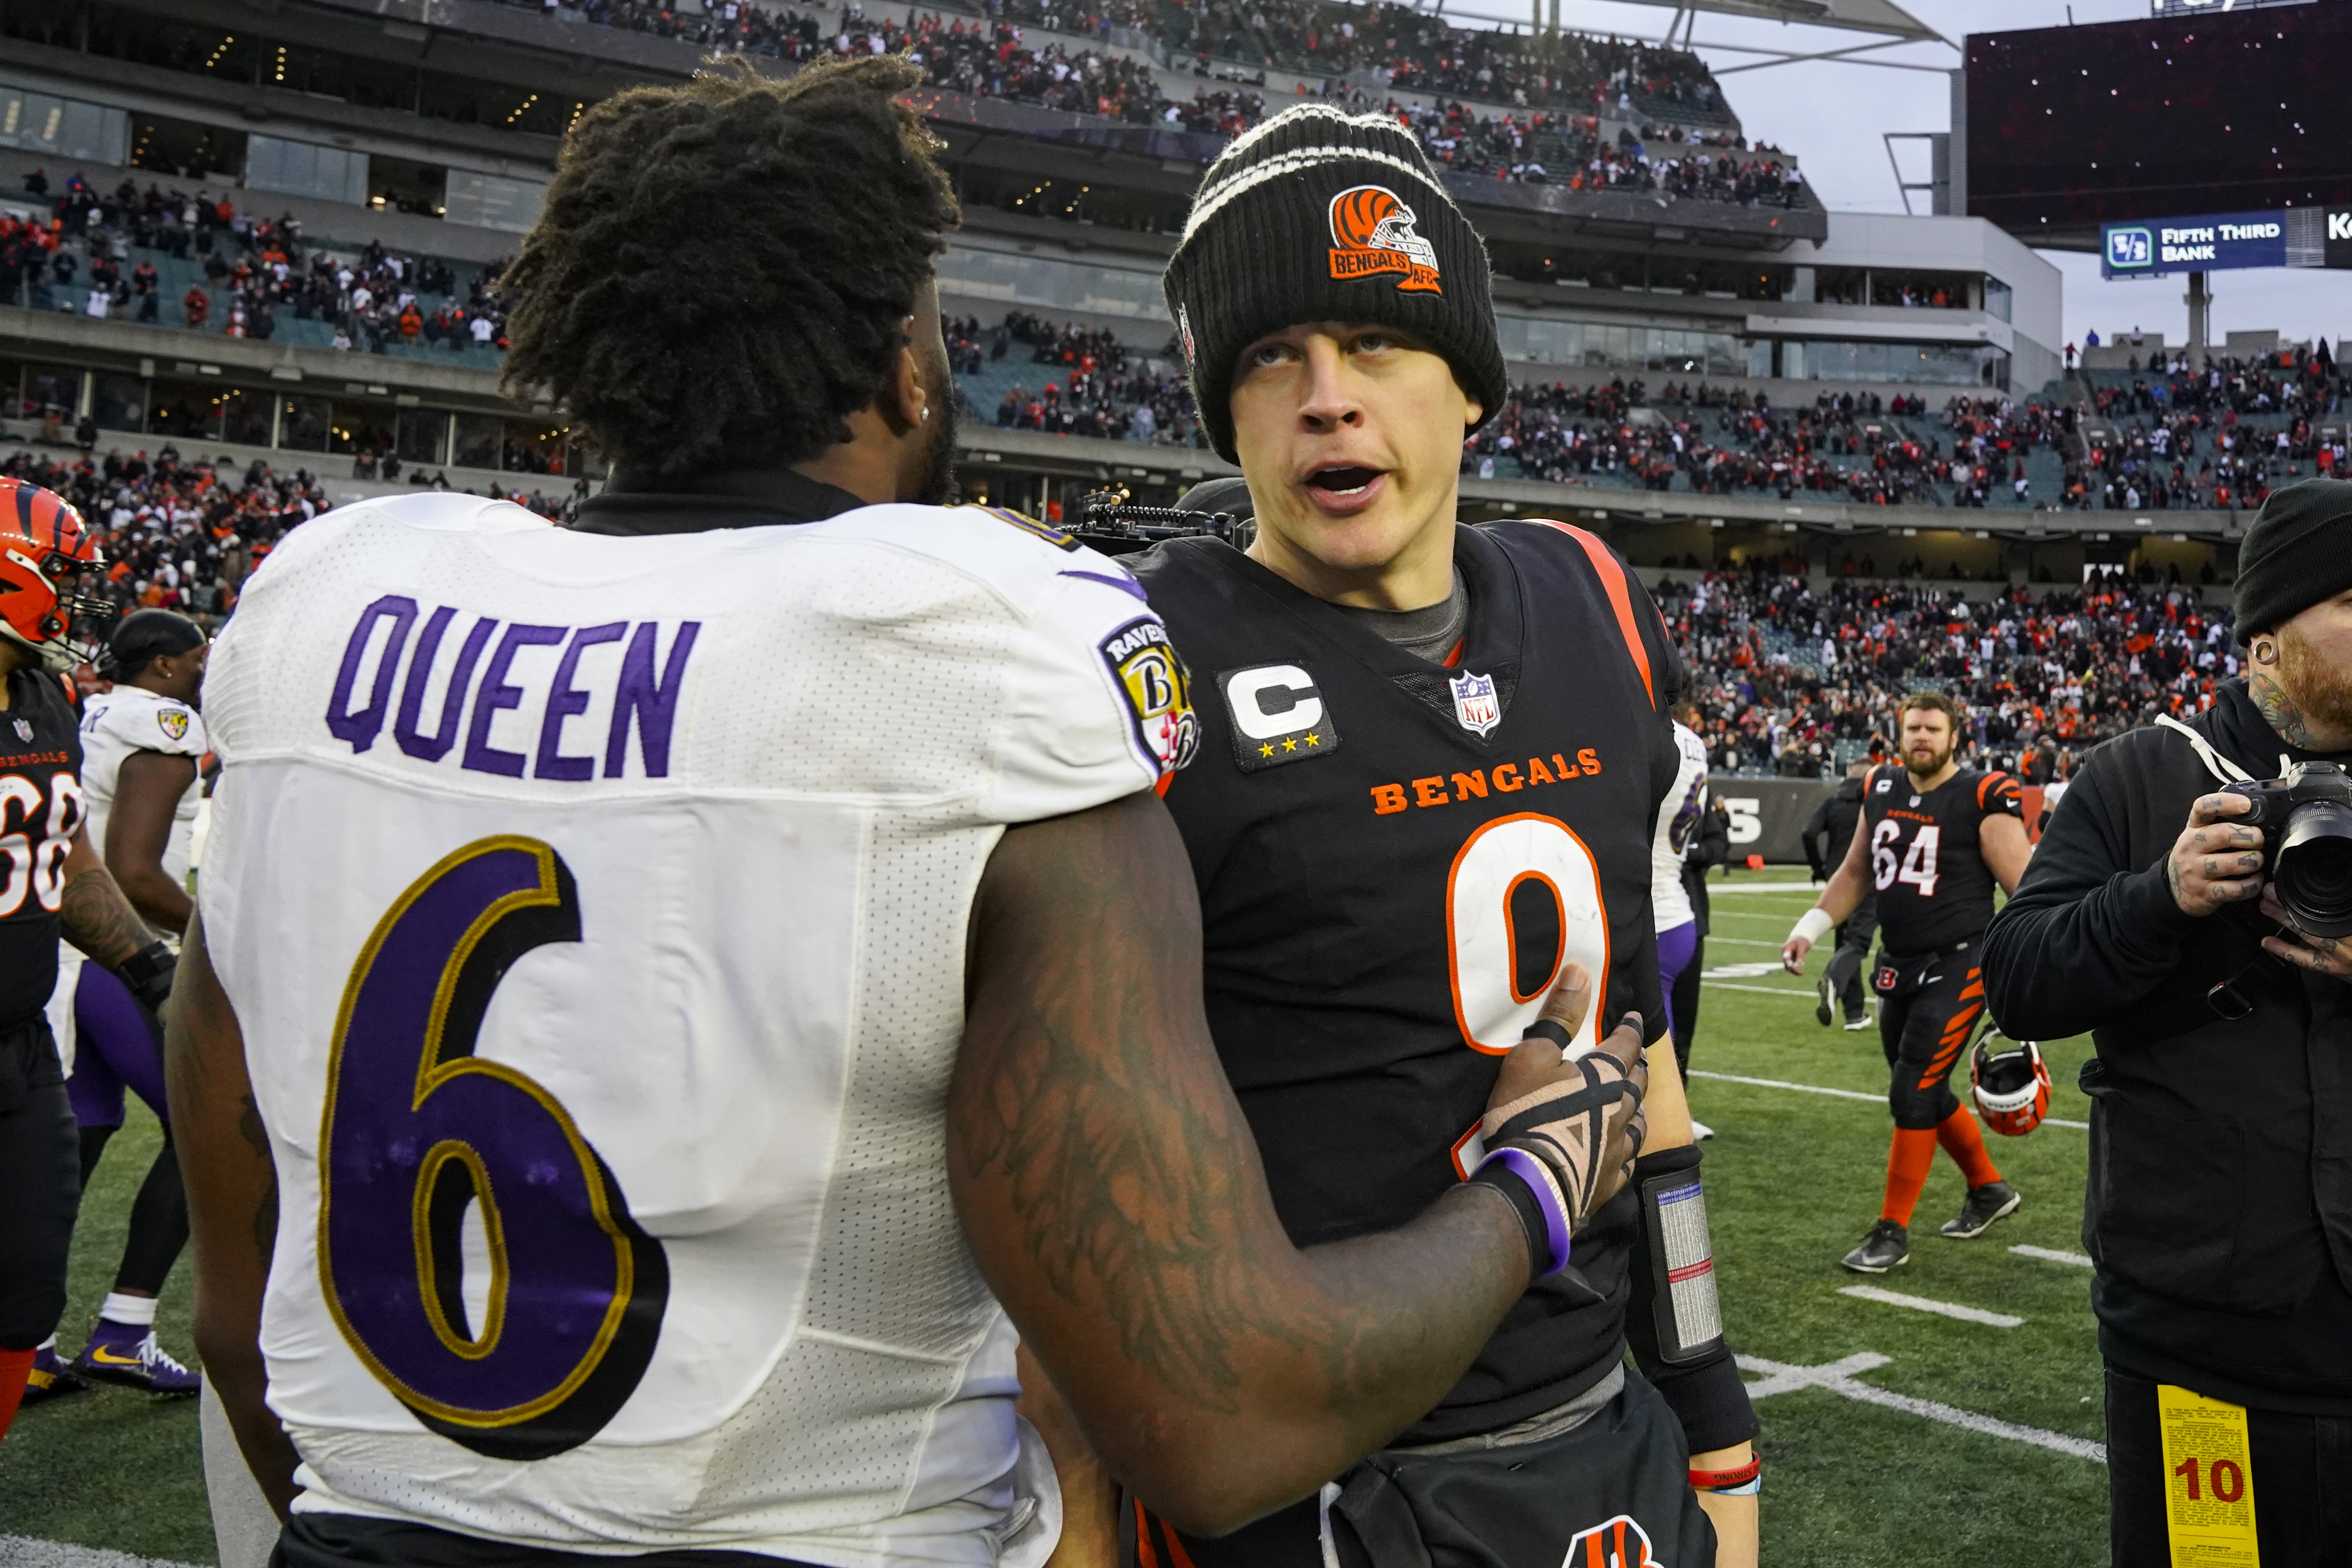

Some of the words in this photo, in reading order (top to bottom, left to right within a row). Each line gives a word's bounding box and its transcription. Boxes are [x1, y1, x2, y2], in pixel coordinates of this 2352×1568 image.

[2161, 227, 2214, 245] FIFTH
[2218, 223, 2281, 241] THIRD
[2328, 212, 2352, 240] K
[1334, 253, 1407, 274] BENGALS
[2161, 244, 2216, 262] BANK
[1413, 270, 1433, 285] AFC
[325, 594, 702, 781] QUEEN
[1226, 664, 1323, 739] C
[1462, 698, 1494, 724] NFL
[1370, 748, 1603, 816] BENGALS
[1726, 797, 1762, 844] 5
[1871, 818, 1941, 897] 64
[315, 834, 671, 1462] 6
[1714, 1467, 1753, 1483] STRONG
[2175, 1457, 2244, 1503] 10
